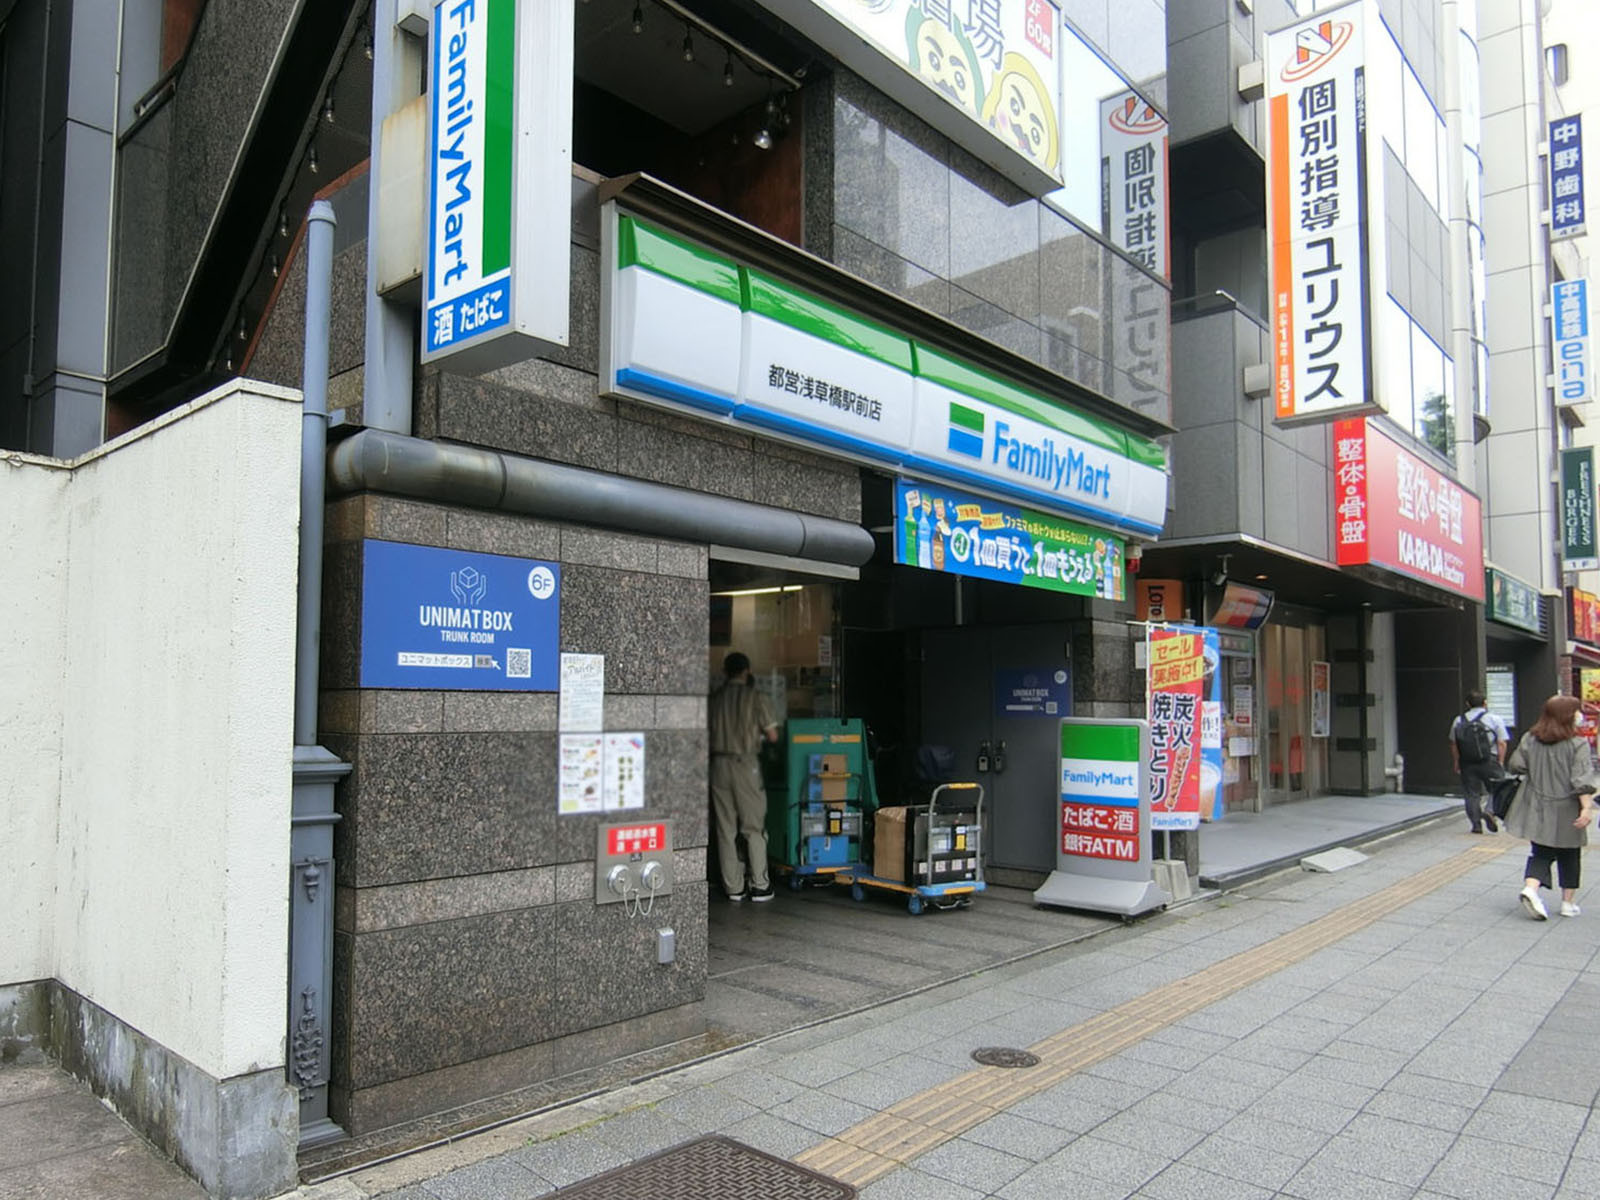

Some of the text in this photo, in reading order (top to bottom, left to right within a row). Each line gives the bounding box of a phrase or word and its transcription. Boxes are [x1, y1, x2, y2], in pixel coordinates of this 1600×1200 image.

[440, 0, 475, 287] FamilyMart
[1553, 122, 1582, 224] 中野歯科
[433, 289, 504, 346] 酒 たばこ
[768, 363, 883, 423] 都営浅草橋駅前店
[993, 420, 1111, 499] FamilyMart
[532, 573, 551, 592] 6F
[419, 605, 513, 632] UNIMAT BOX
[440, 630, 495, 645] TRUNK ROOM
[1156, 639, 1191, 660] セール
[1150, 692, 1174, 802] 焼きとり
[1173, 693, 1196, 748] 炭火
[1063, 769, 1134, 788] FamilyMart
[1064, 833, 1134, 858] 銀行ATM
